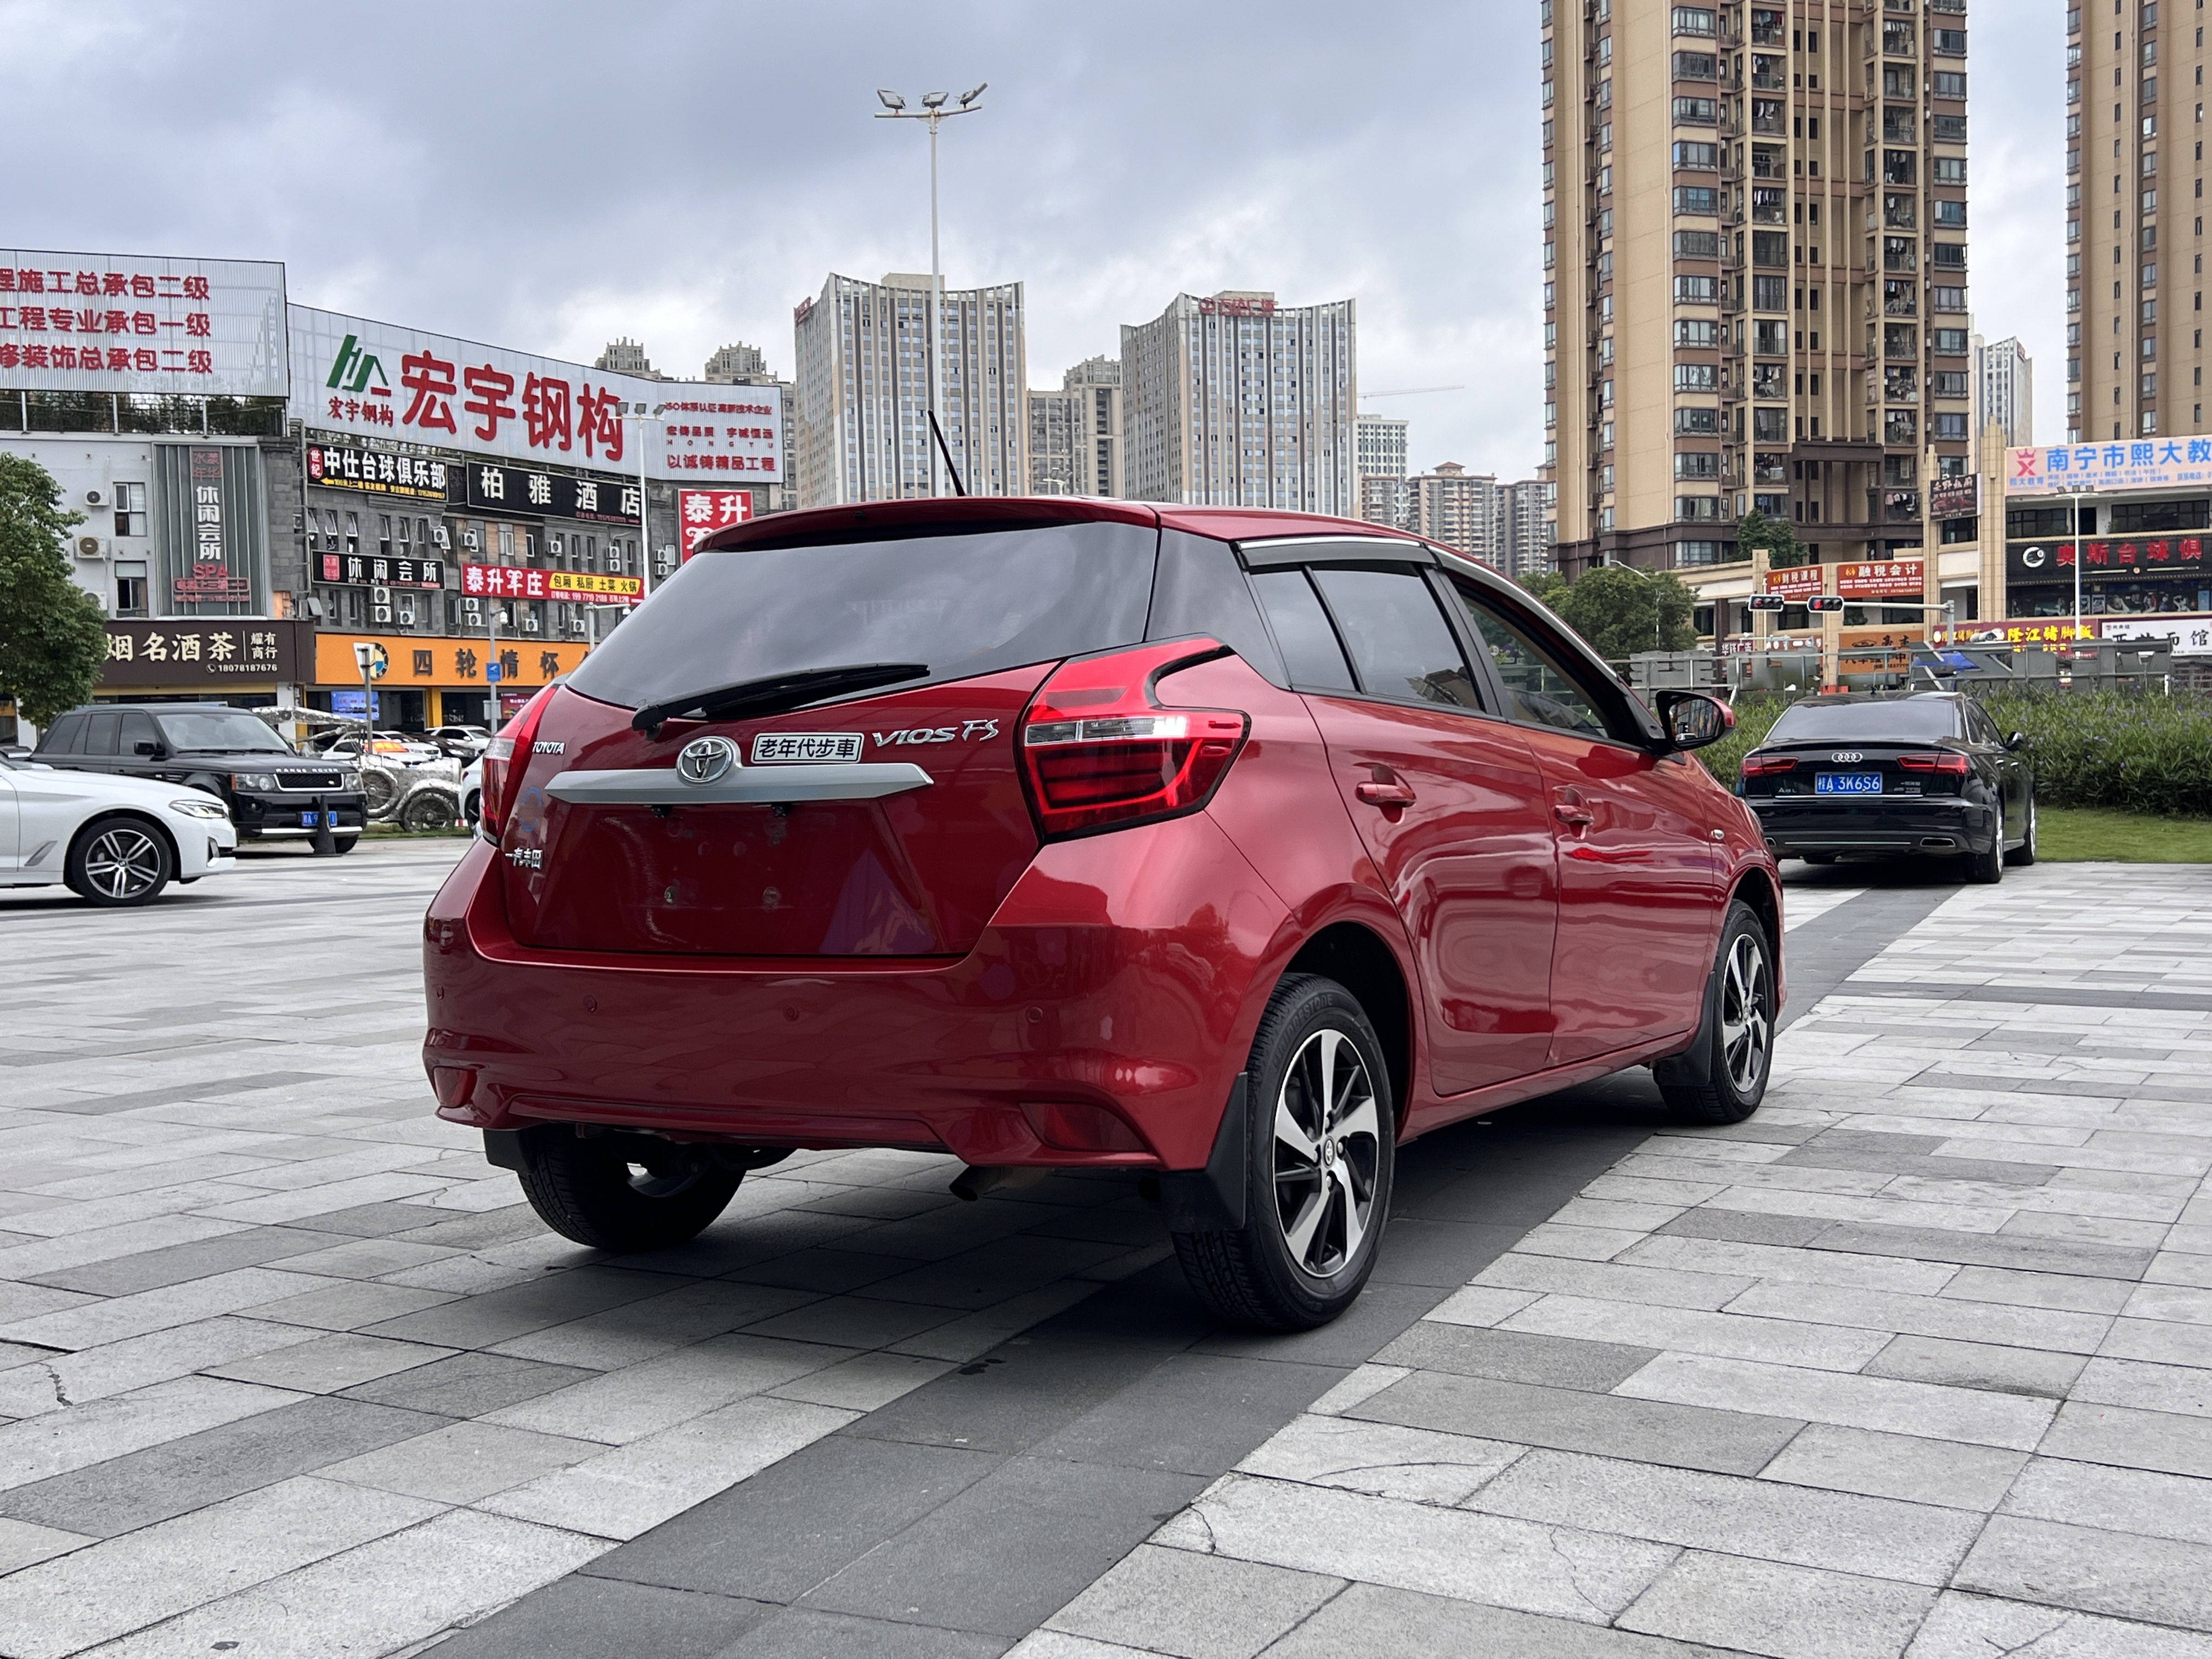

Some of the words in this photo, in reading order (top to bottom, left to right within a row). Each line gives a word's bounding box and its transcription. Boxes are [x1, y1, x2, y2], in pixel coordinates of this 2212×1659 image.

[0, 306, 211, 337] 工程专业承包一级
[0, 342, 213, 374] 修装饰总承包二级
[327, 395, 394, 428] 宏宇钢构
[400, 349, 624, 461] 宏宇钢构
[324, 447, 446, 489] 中仕台球俱乐部
[2046, 438, 2212, 473] 南宁市熙大教
[481, 466, 641, 517] 柏雅酒店
[196, 485, 222, 561] 休闲会所
[685, 494, 747, 523] 泰升
[193, 563, 229, 579] SPA
[347, 556, 437, 582] 休闲会所
[599, 578, 616, 591] 土菜
[620, 580, 637, 593] 火锅
[104, 631, 237, 662] 烟名酒茶
[218, 663, 278, 672] 18078187676
[413, 647, 589, 680] 四轮情怀
[532, 741, 565, 754] TOYOTA
[758, 737, 857, 758] 老年代步車
[871, 726, 958, 747] VIOS
[962, 718, 999, 742] FS
